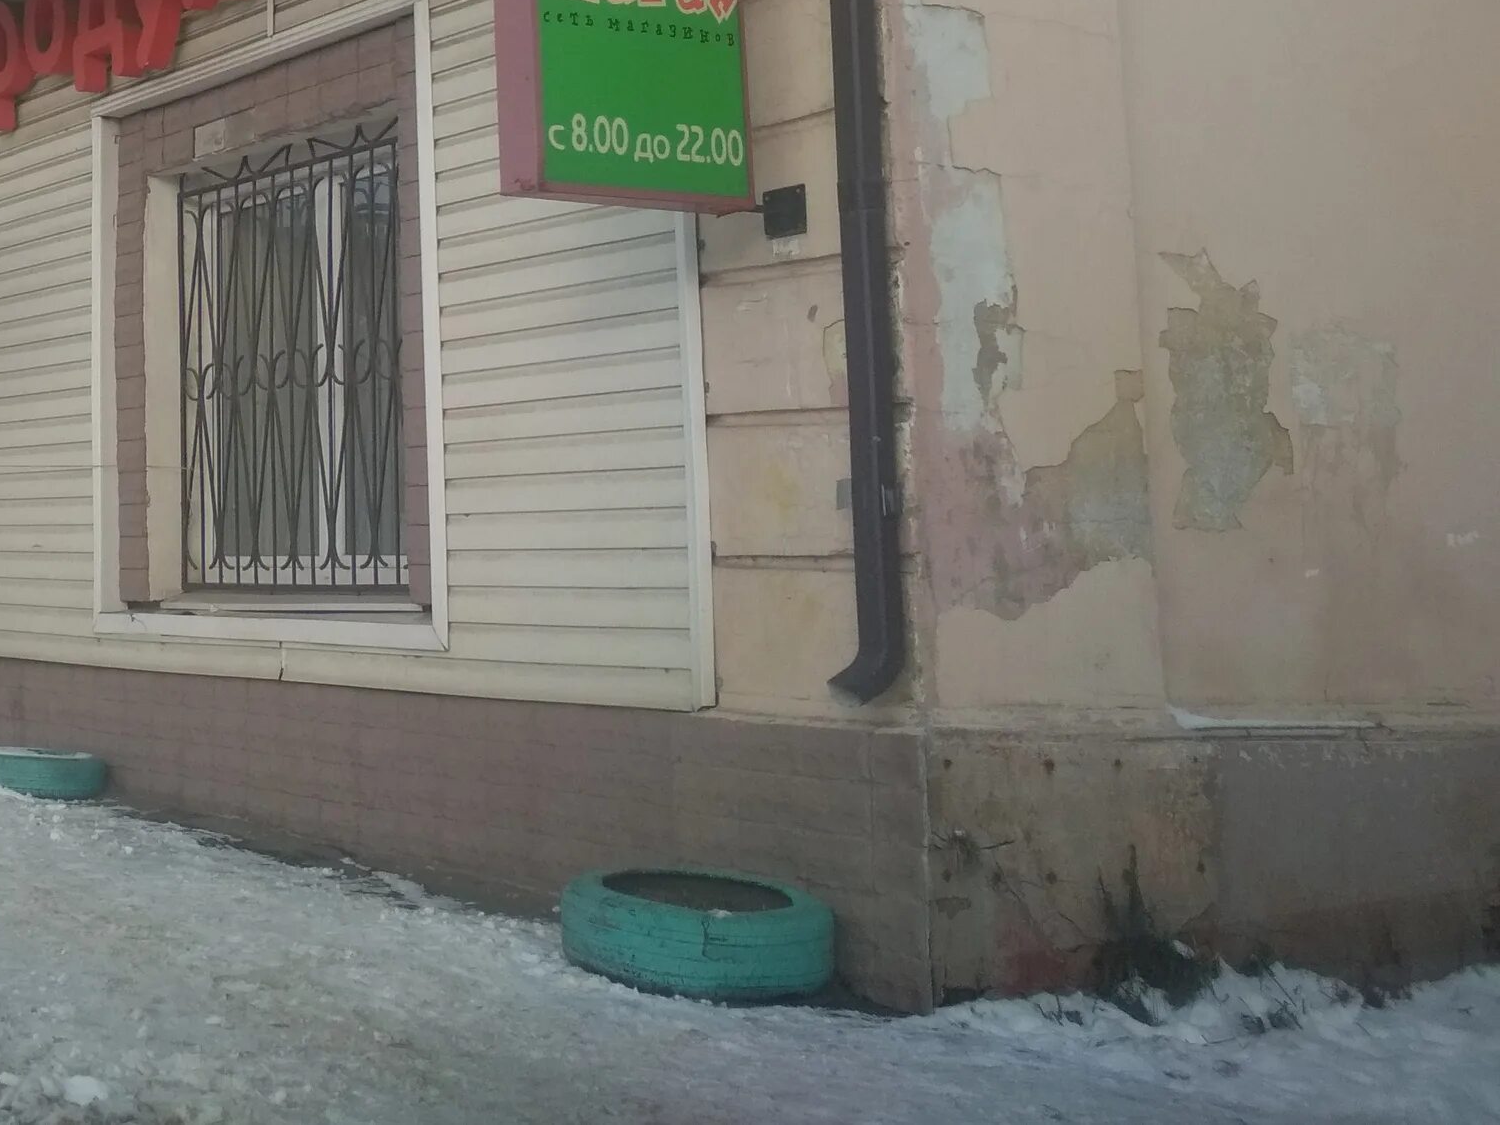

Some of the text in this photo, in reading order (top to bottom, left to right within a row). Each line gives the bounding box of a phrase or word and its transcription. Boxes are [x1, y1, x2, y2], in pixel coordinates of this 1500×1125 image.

[543, 10, 735, 47] сеть магазинов
[571, 113, 629, 155] 8.00
[634, 132, 671, 164] до
[676, 123, 743, 167] 22.00
